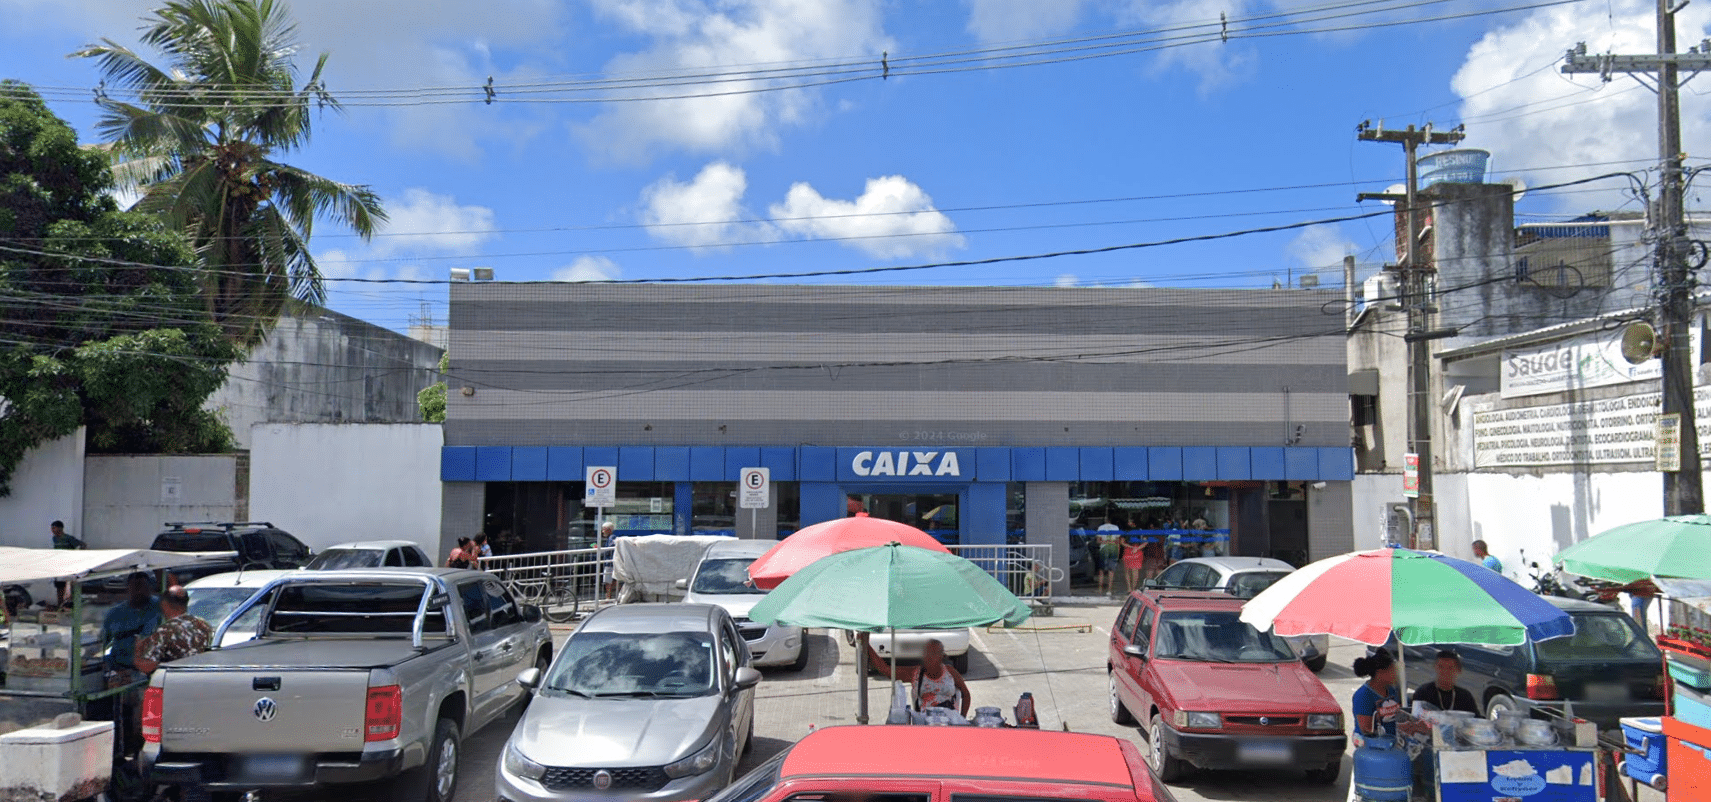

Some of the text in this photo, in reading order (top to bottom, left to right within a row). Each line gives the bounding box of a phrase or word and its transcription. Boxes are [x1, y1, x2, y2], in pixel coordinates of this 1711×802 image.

[852, 451, 960, 477] CAIXA
[597, 473, 605, 484] E
[751, 474, 759, 486] E
